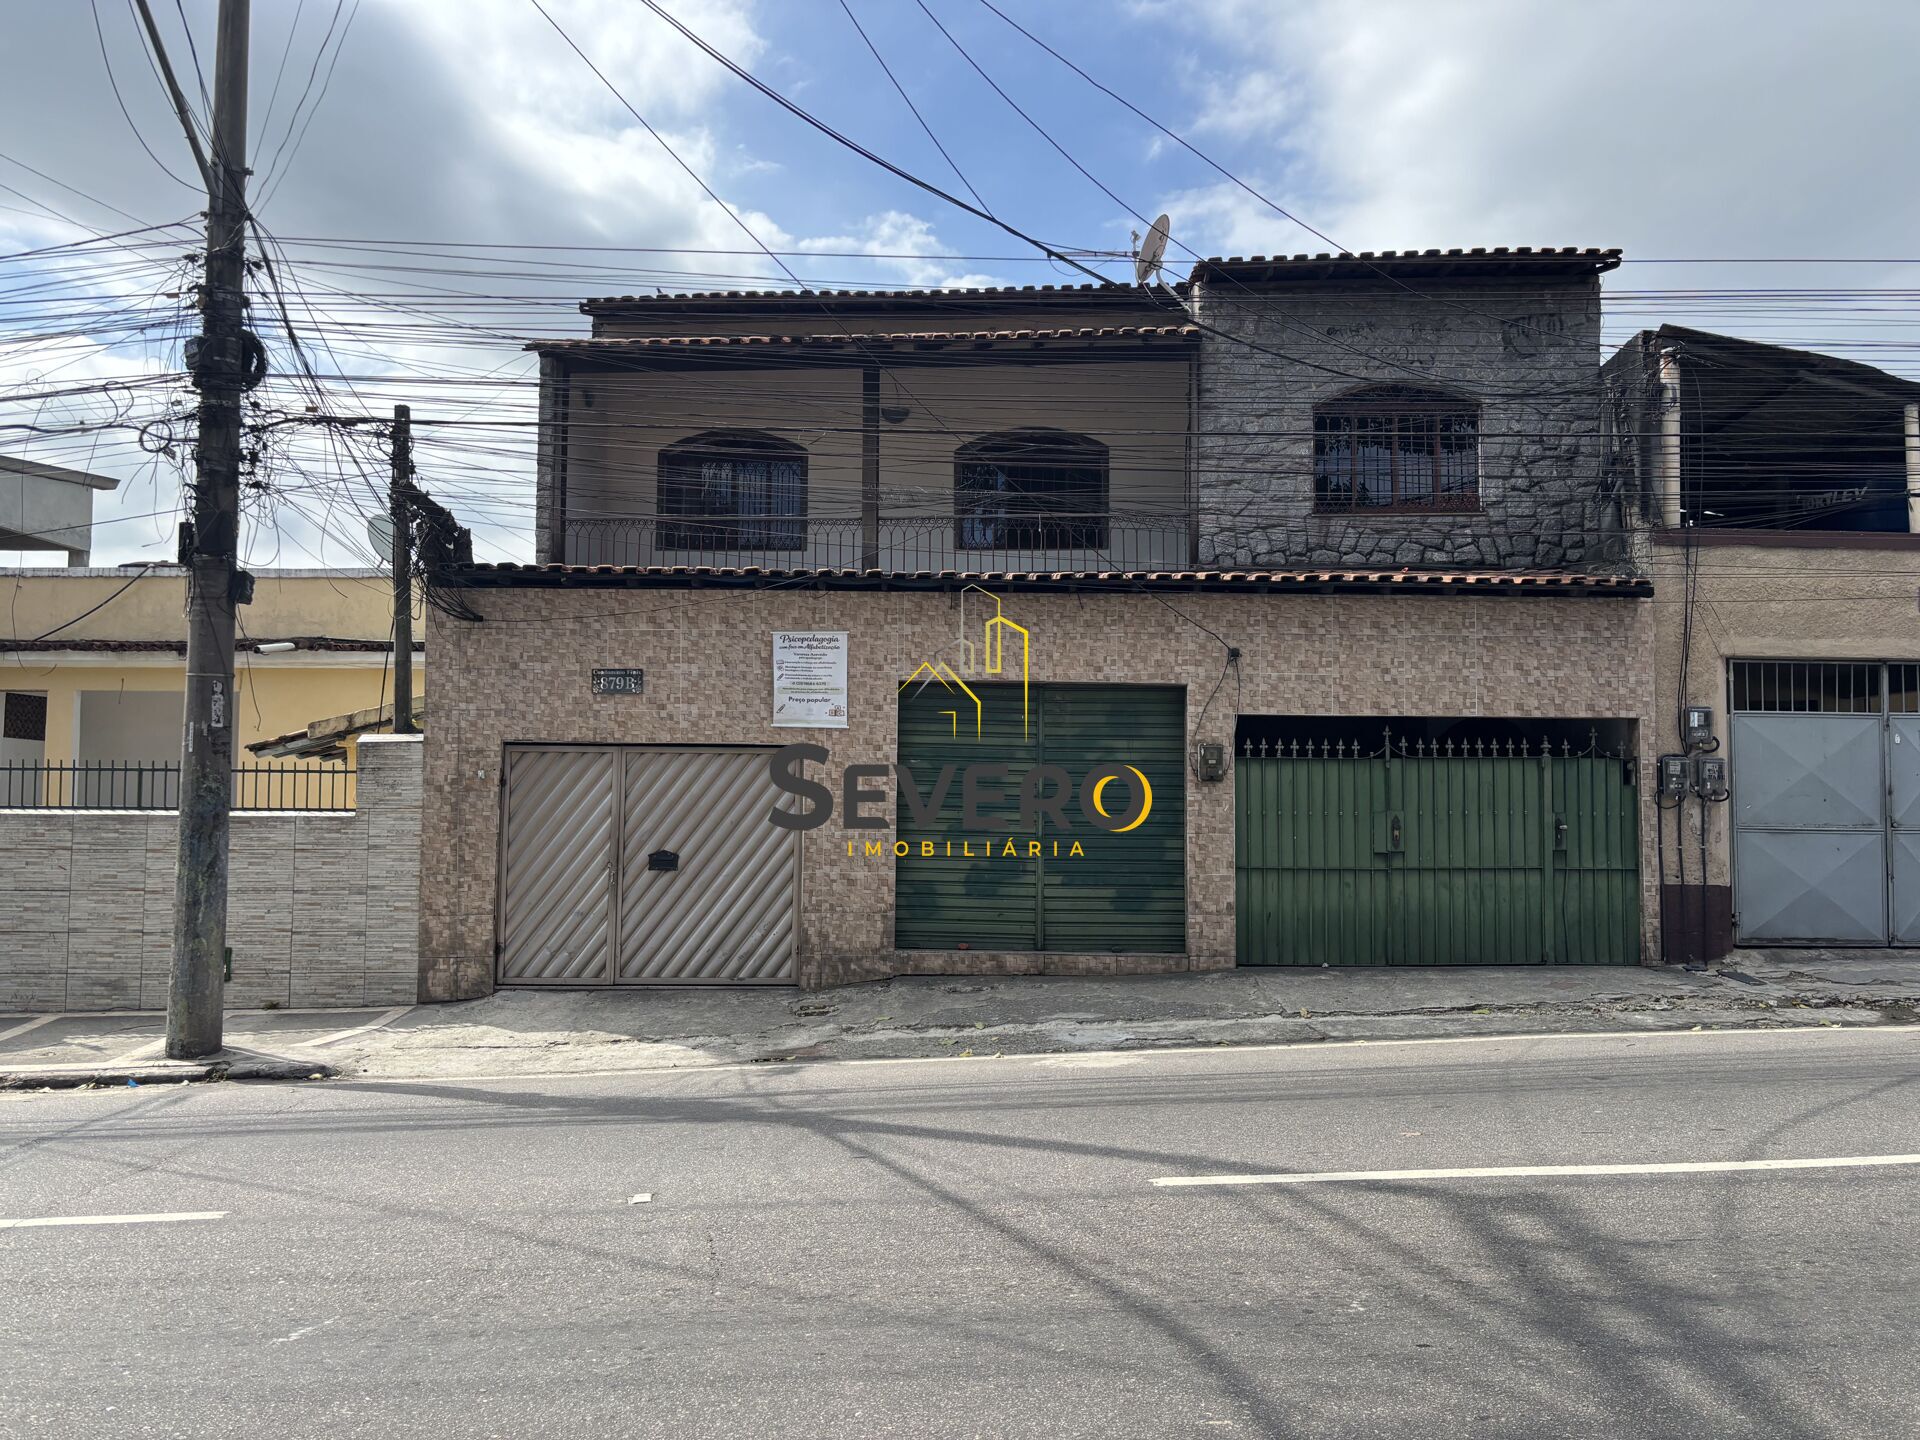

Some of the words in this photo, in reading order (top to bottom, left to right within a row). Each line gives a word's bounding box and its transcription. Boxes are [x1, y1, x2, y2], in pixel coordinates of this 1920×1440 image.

[780, 634, 840, 645] Psicopedagogia
[600, 676, 635, 689] 879B
[806, 696, 831, 704] popular
